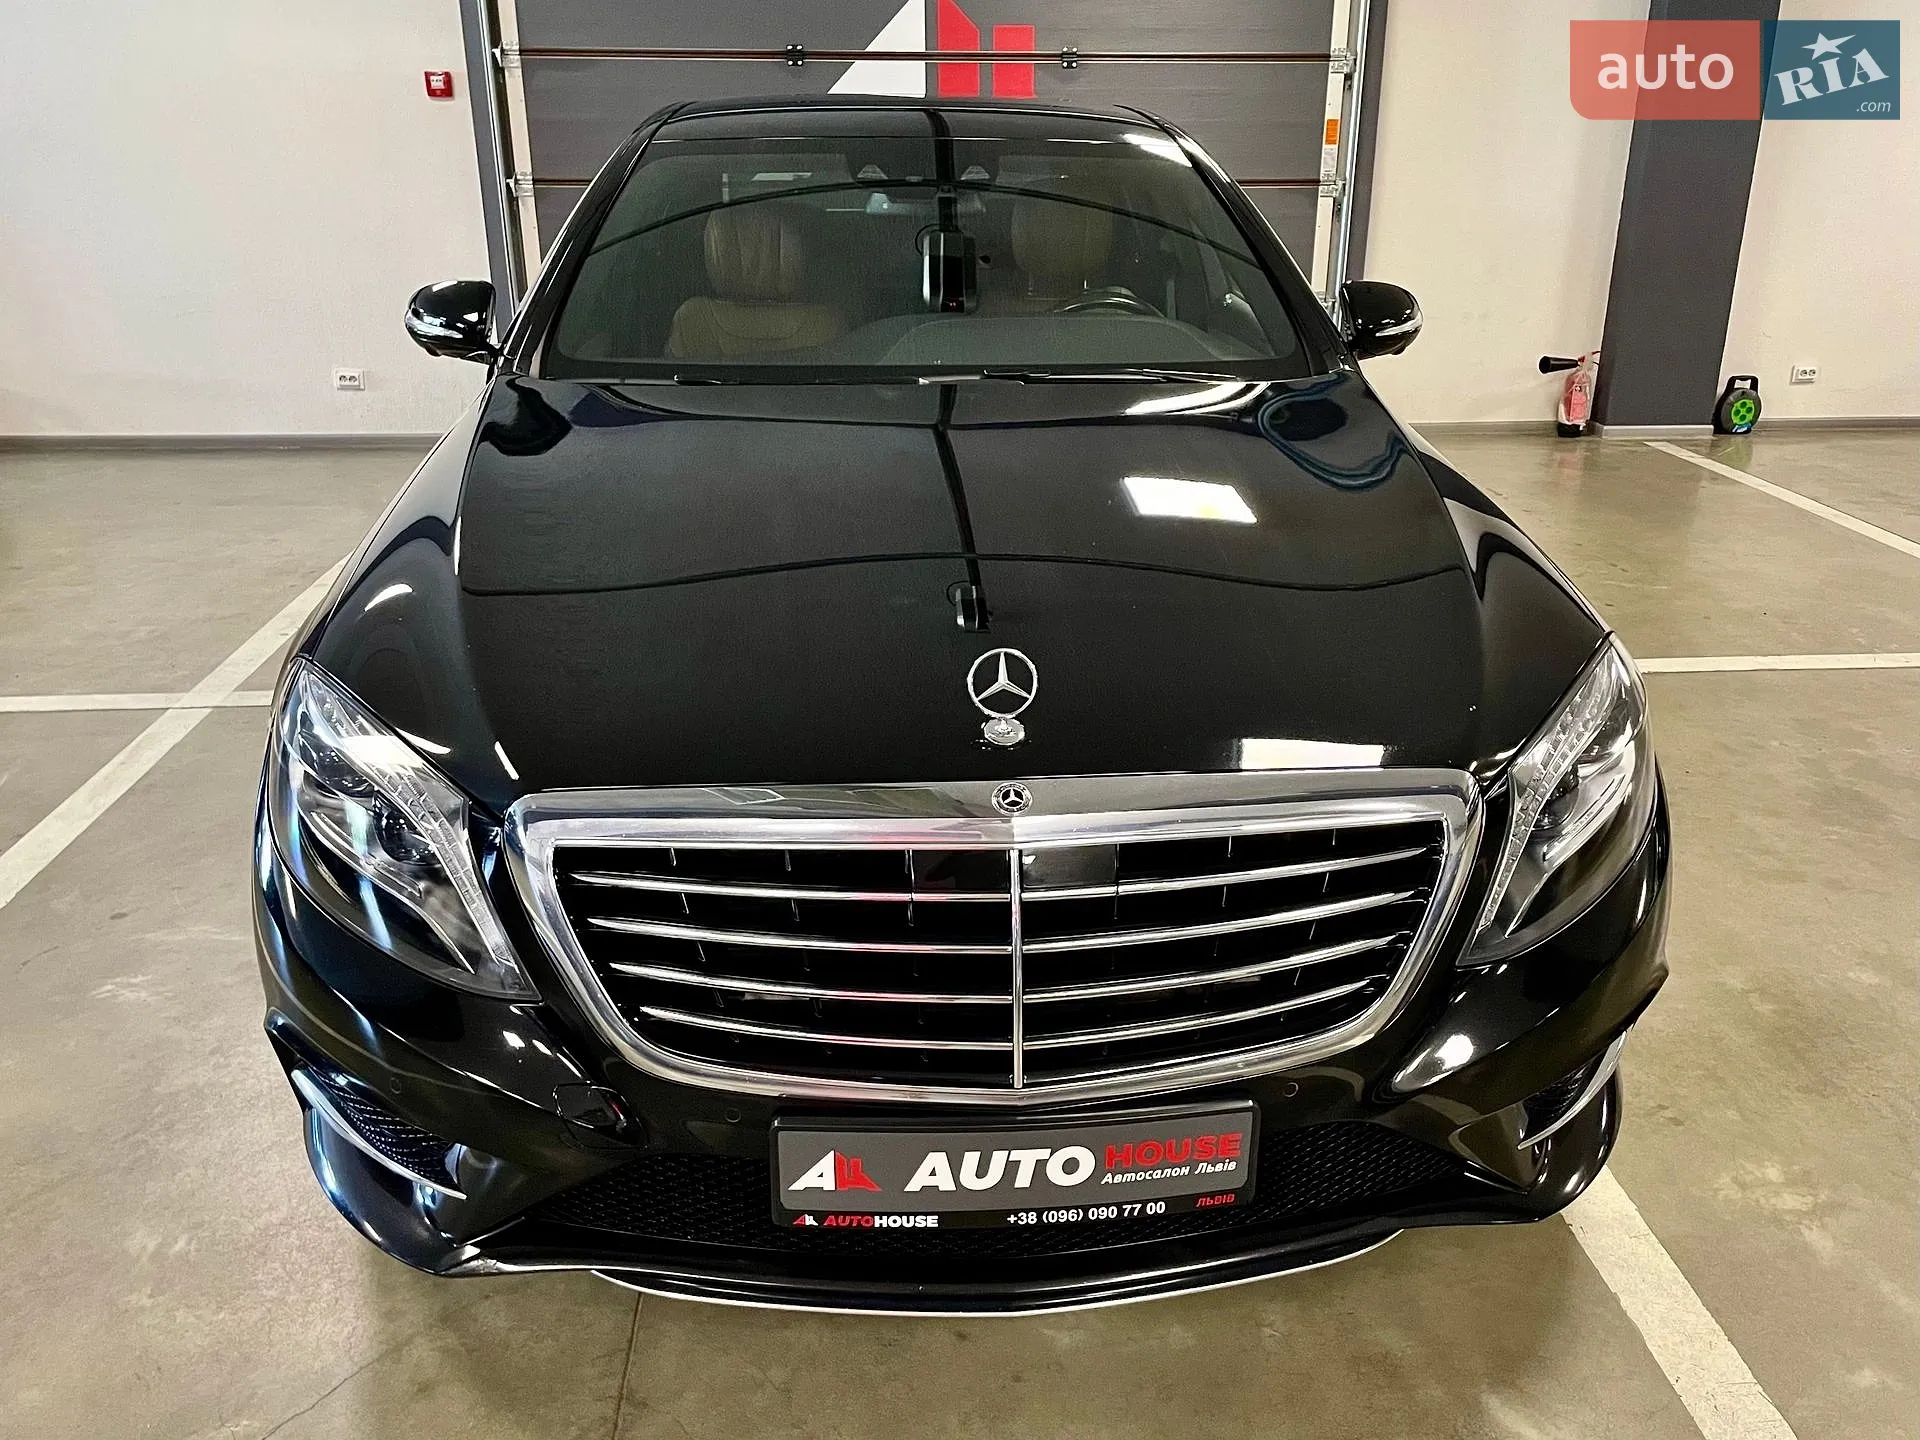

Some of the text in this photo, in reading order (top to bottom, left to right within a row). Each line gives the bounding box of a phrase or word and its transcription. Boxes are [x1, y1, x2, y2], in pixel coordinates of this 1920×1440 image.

[903, 1132, 1243, 1192] AUTO HOUSE
[1100, 1159, 1237, 1185] Автосалон Львів
[1006, 1201, 1166, 1225] +38 (096) 090 77 00
